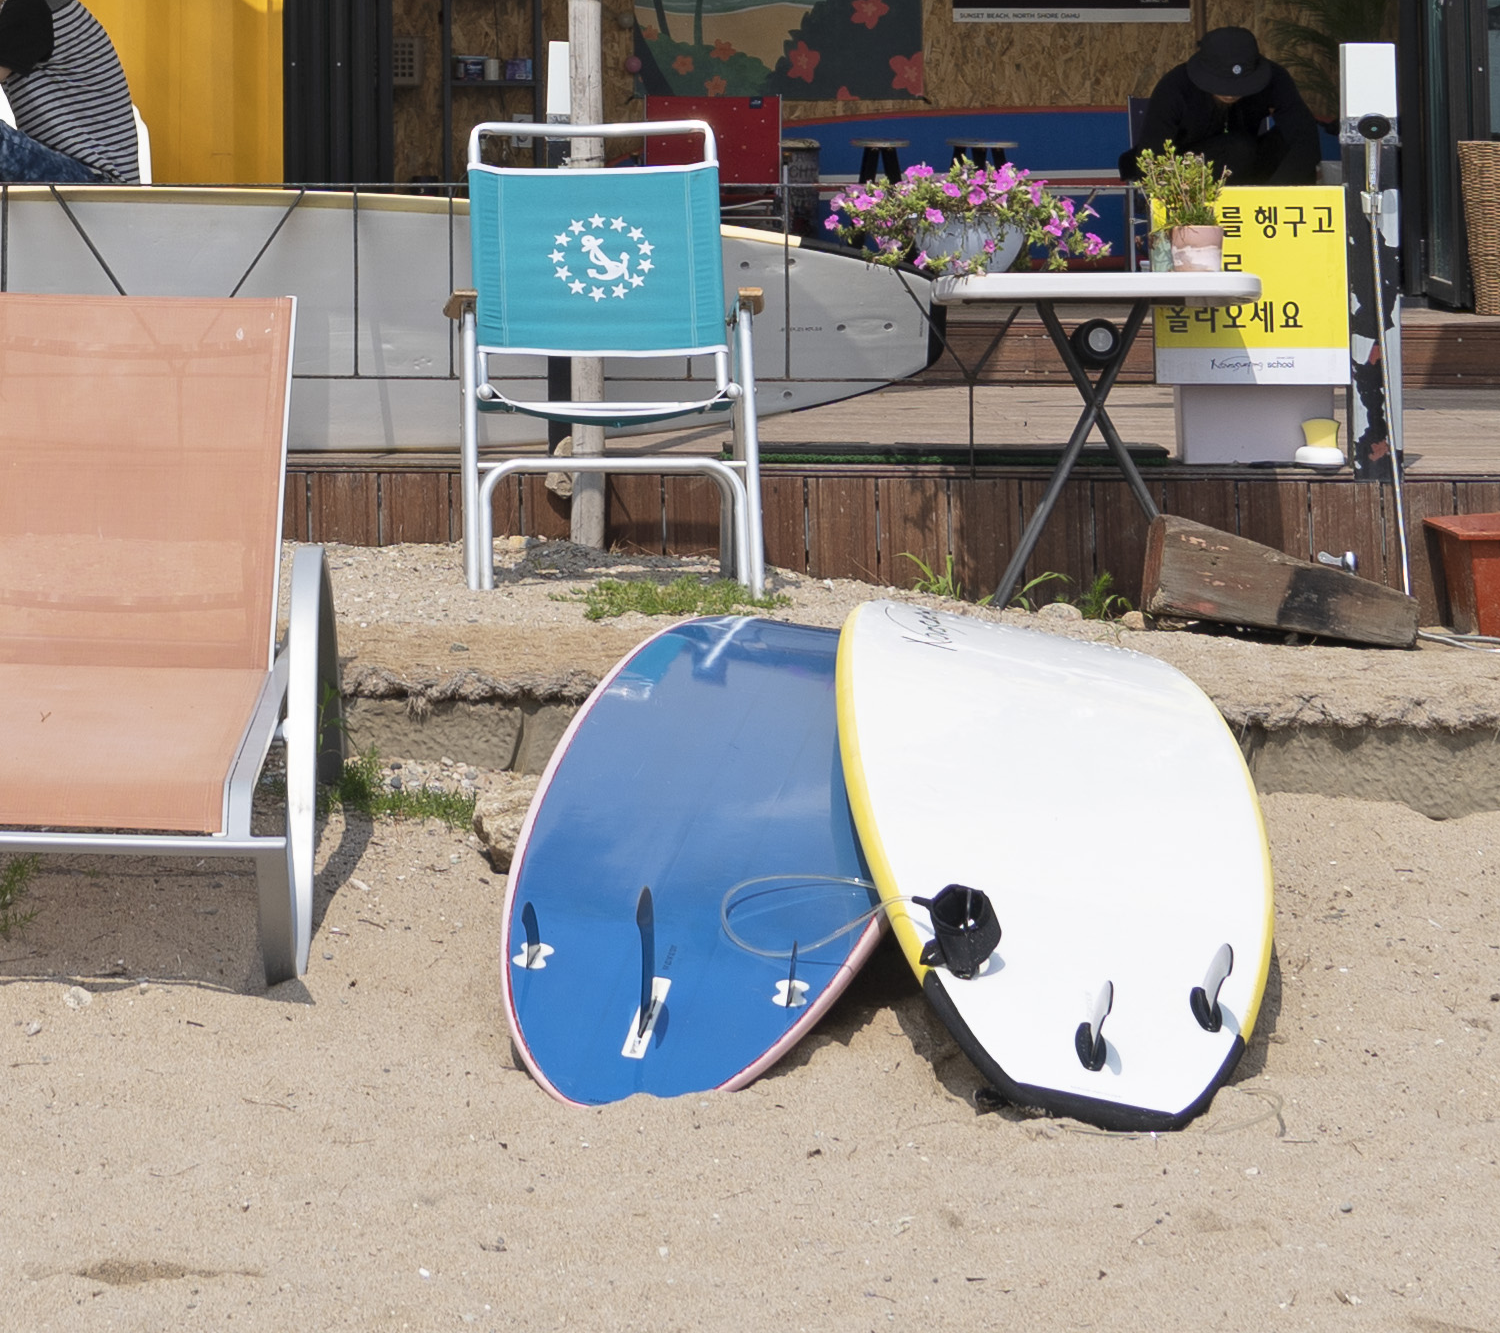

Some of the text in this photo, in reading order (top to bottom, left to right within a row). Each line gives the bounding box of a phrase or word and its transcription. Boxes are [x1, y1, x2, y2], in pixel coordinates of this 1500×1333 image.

[959, 12, 984, 20] SUNSET
[1012, 12, 1035, 20] NORTH
[1037, 12, 1059, 20] SHORE
[1254, 205, 1335, 239] 헹구고
[1165, 301, 1303, 334] 올라오세요
[1267, 358, 1295, 370] school
